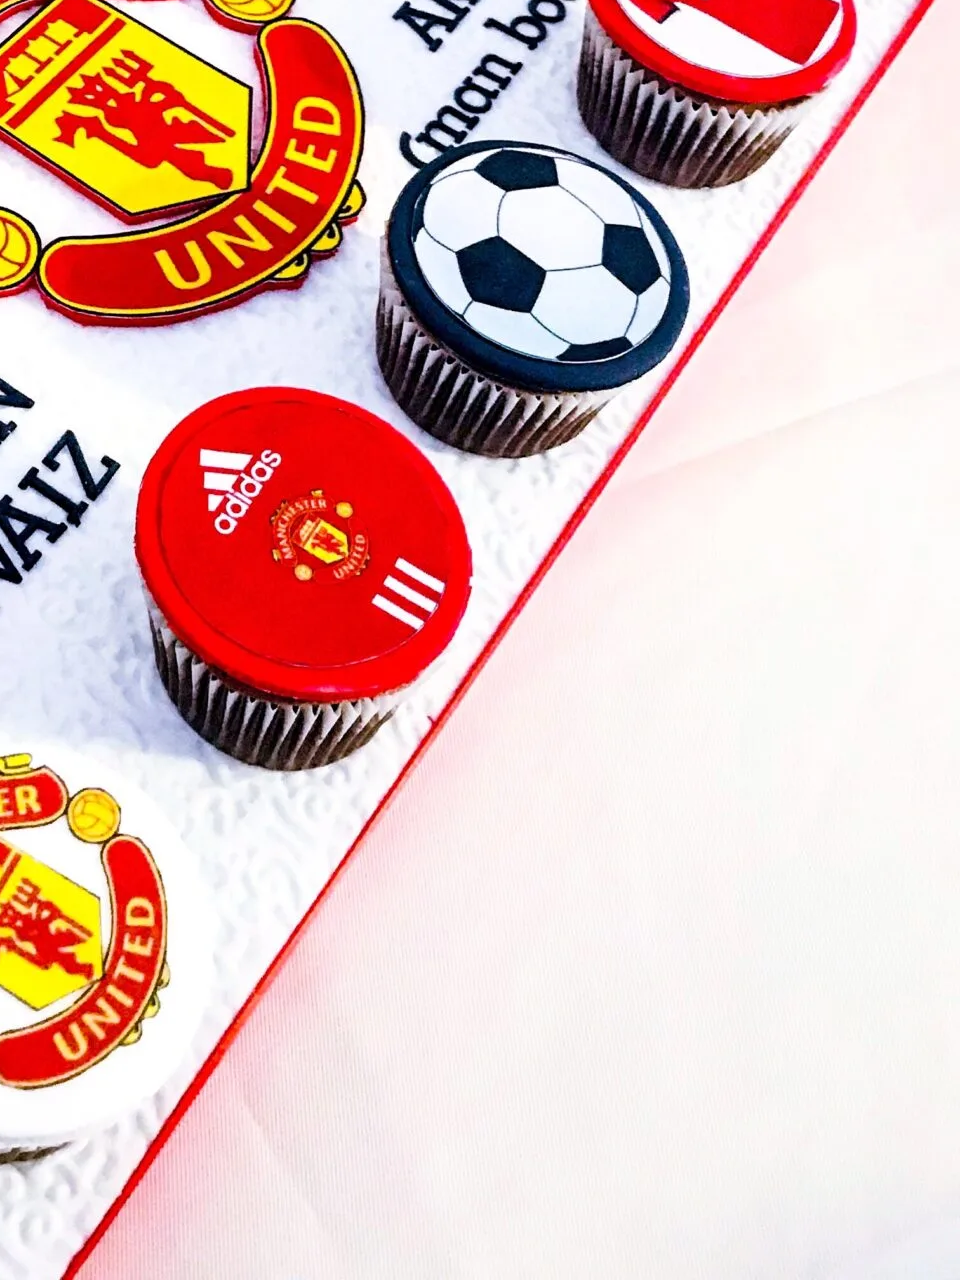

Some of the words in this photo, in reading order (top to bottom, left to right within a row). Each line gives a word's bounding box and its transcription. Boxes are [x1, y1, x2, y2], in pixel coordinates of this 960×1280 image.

[152, 95, 343, 292] UNITED
[213, 448, 283, 536] adidas
[276, 497, 328, 560] MANCHESTER
[332, 533, 366, 580] UNITED
[51, 895, 157, 1063] UNITED
